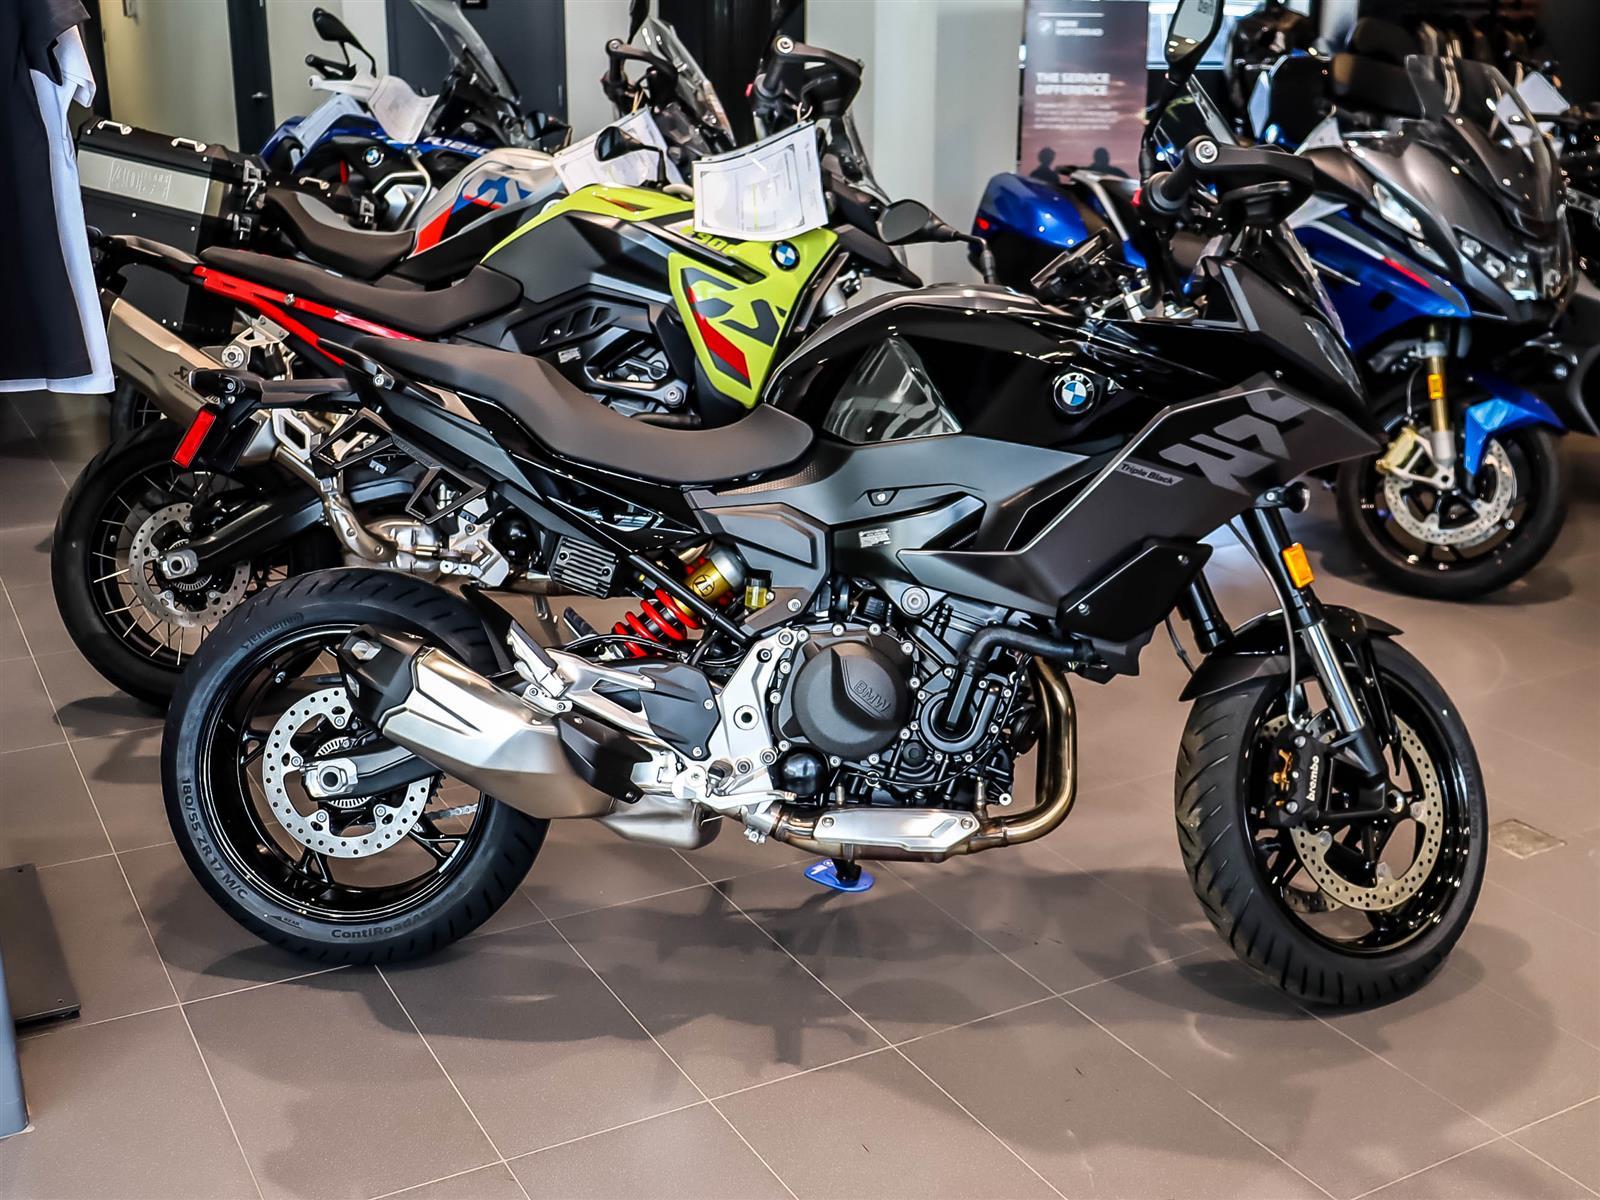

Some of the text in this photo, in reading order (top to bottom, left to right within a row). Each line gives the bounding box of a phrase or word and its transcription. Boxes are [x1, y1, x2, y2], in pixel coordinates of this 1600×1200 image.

[1035, 84, 1109, 96] DIFFERENCE
[1036, 72, 1111, 84] THE SERVICE
[1120, 463, 1174, 485] Triple Black
[853, 680, 892, 712] BMW
[1305, 755, 1320, 802] brembo
[181, 777, 249, 899] 180/55 ZR 17 M/C
